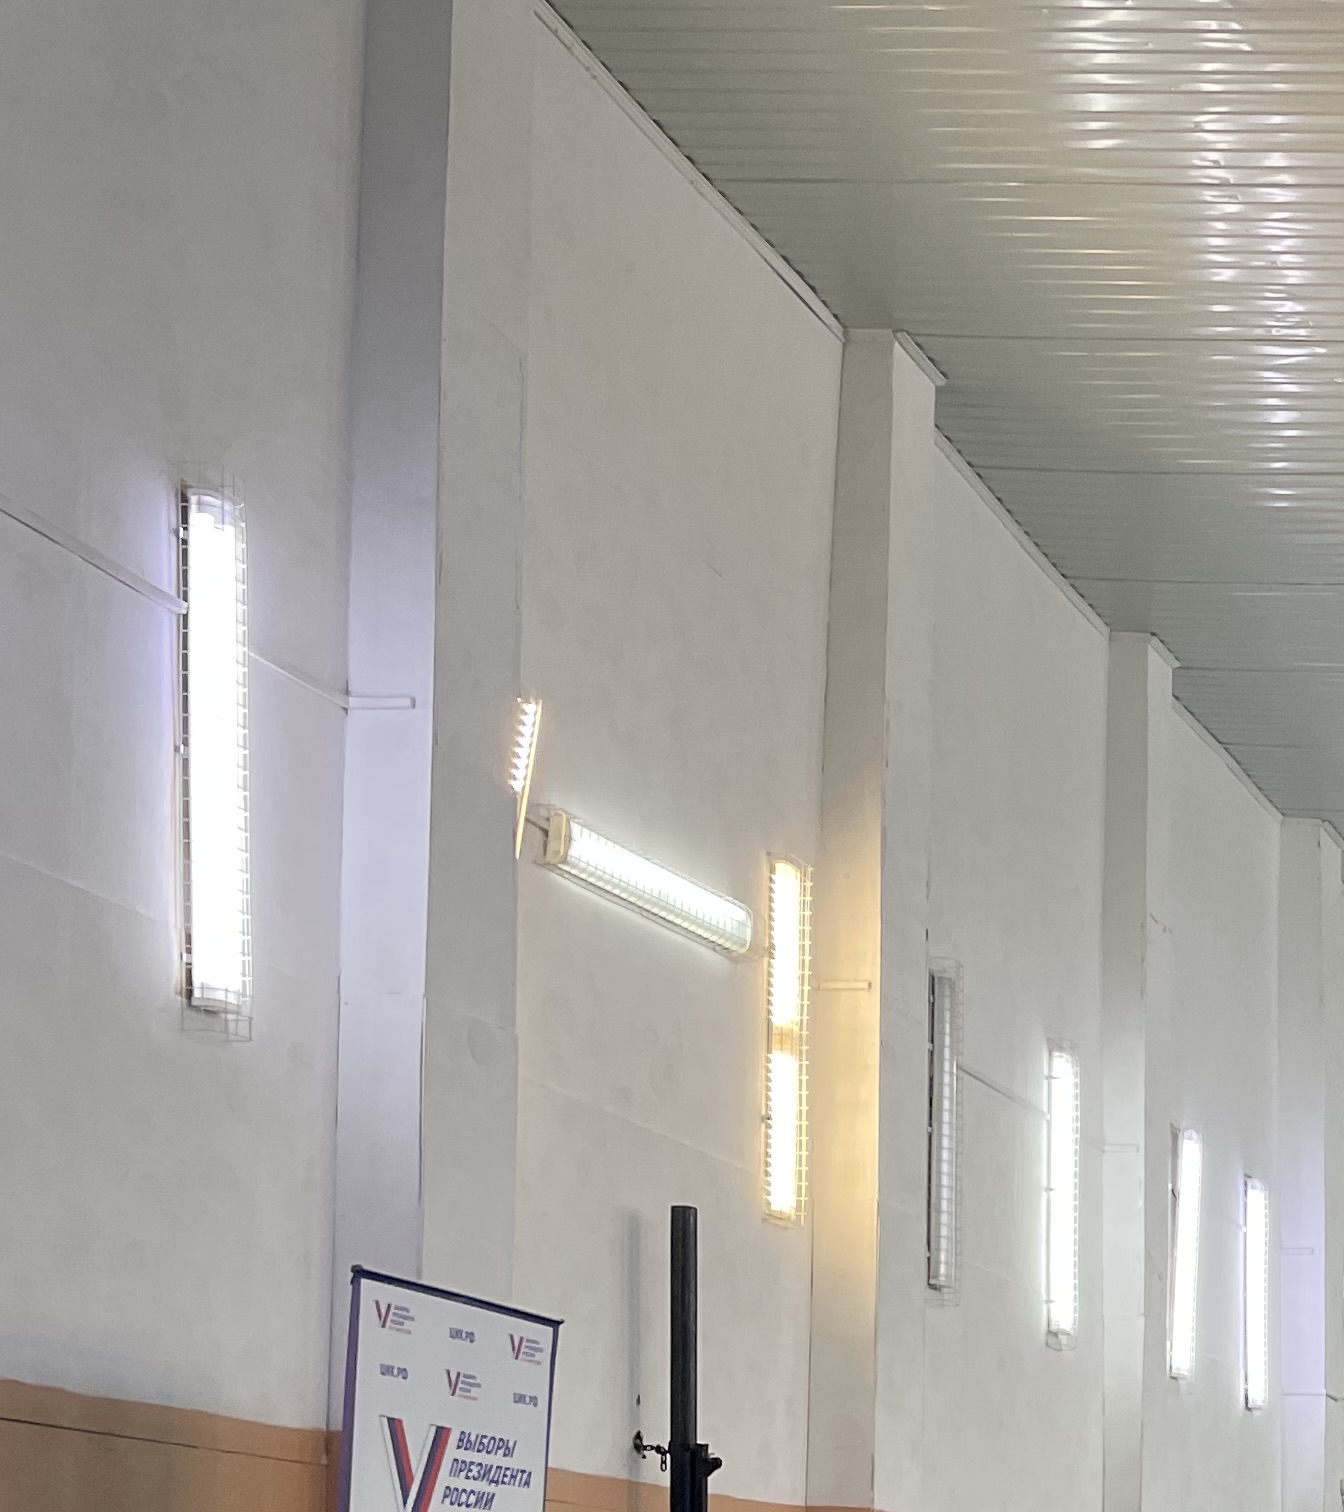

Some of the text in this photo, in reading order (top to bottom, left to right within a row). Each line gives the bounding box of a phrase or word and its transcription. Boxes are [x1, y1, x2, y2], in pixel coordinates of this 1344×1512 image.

[456, 1430, 517, 1458] ВЫБОРЫ
[449, 1458, 533, 1488] ПРЕЗИДЕНТА
[441, 1485, 496, 1511] РОССИИ
